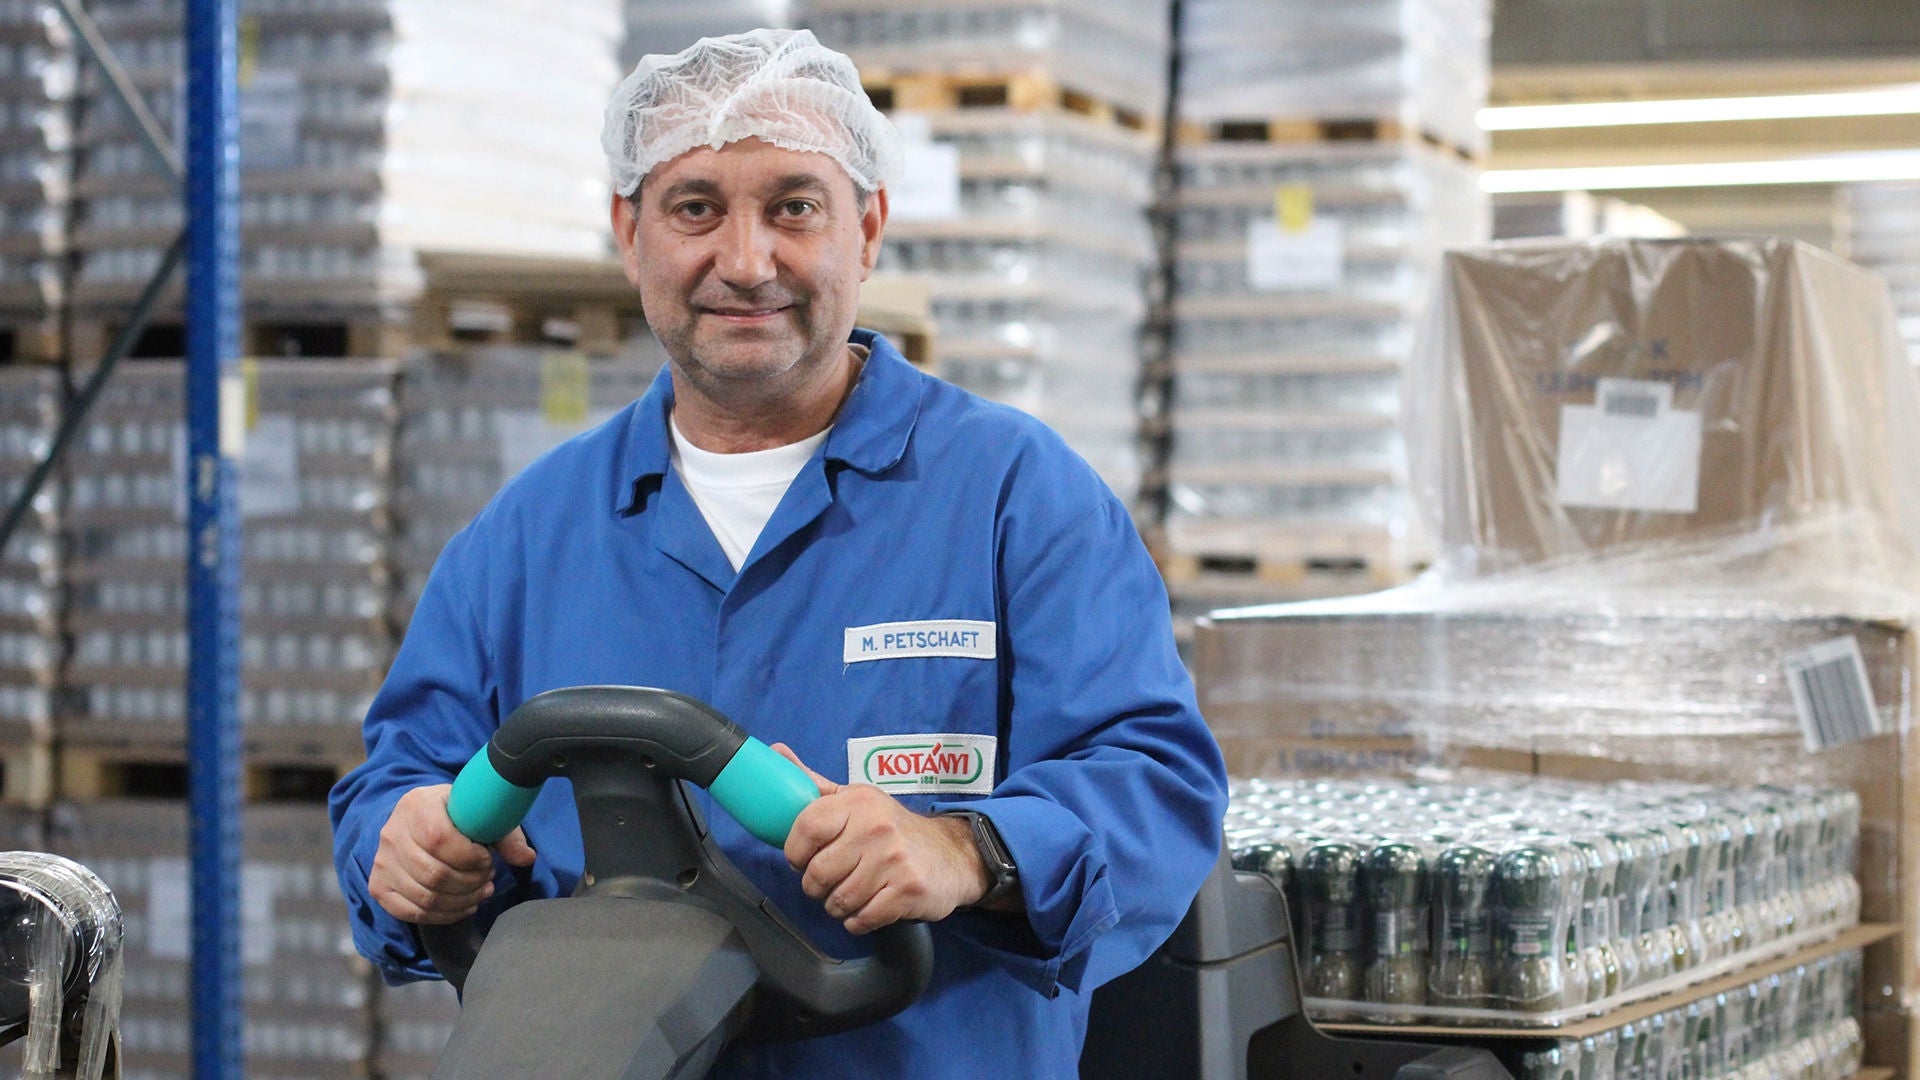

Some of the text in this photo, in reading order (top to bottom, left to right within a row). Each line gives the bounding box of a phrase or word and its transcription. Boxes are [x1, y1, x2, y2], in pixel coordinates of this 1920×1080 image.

[862, 631, 979, 651] M. PETSCHAFT
[877, 742, 969, 775] KOTÁNYI
[920, 775, 938, 784] 1881
